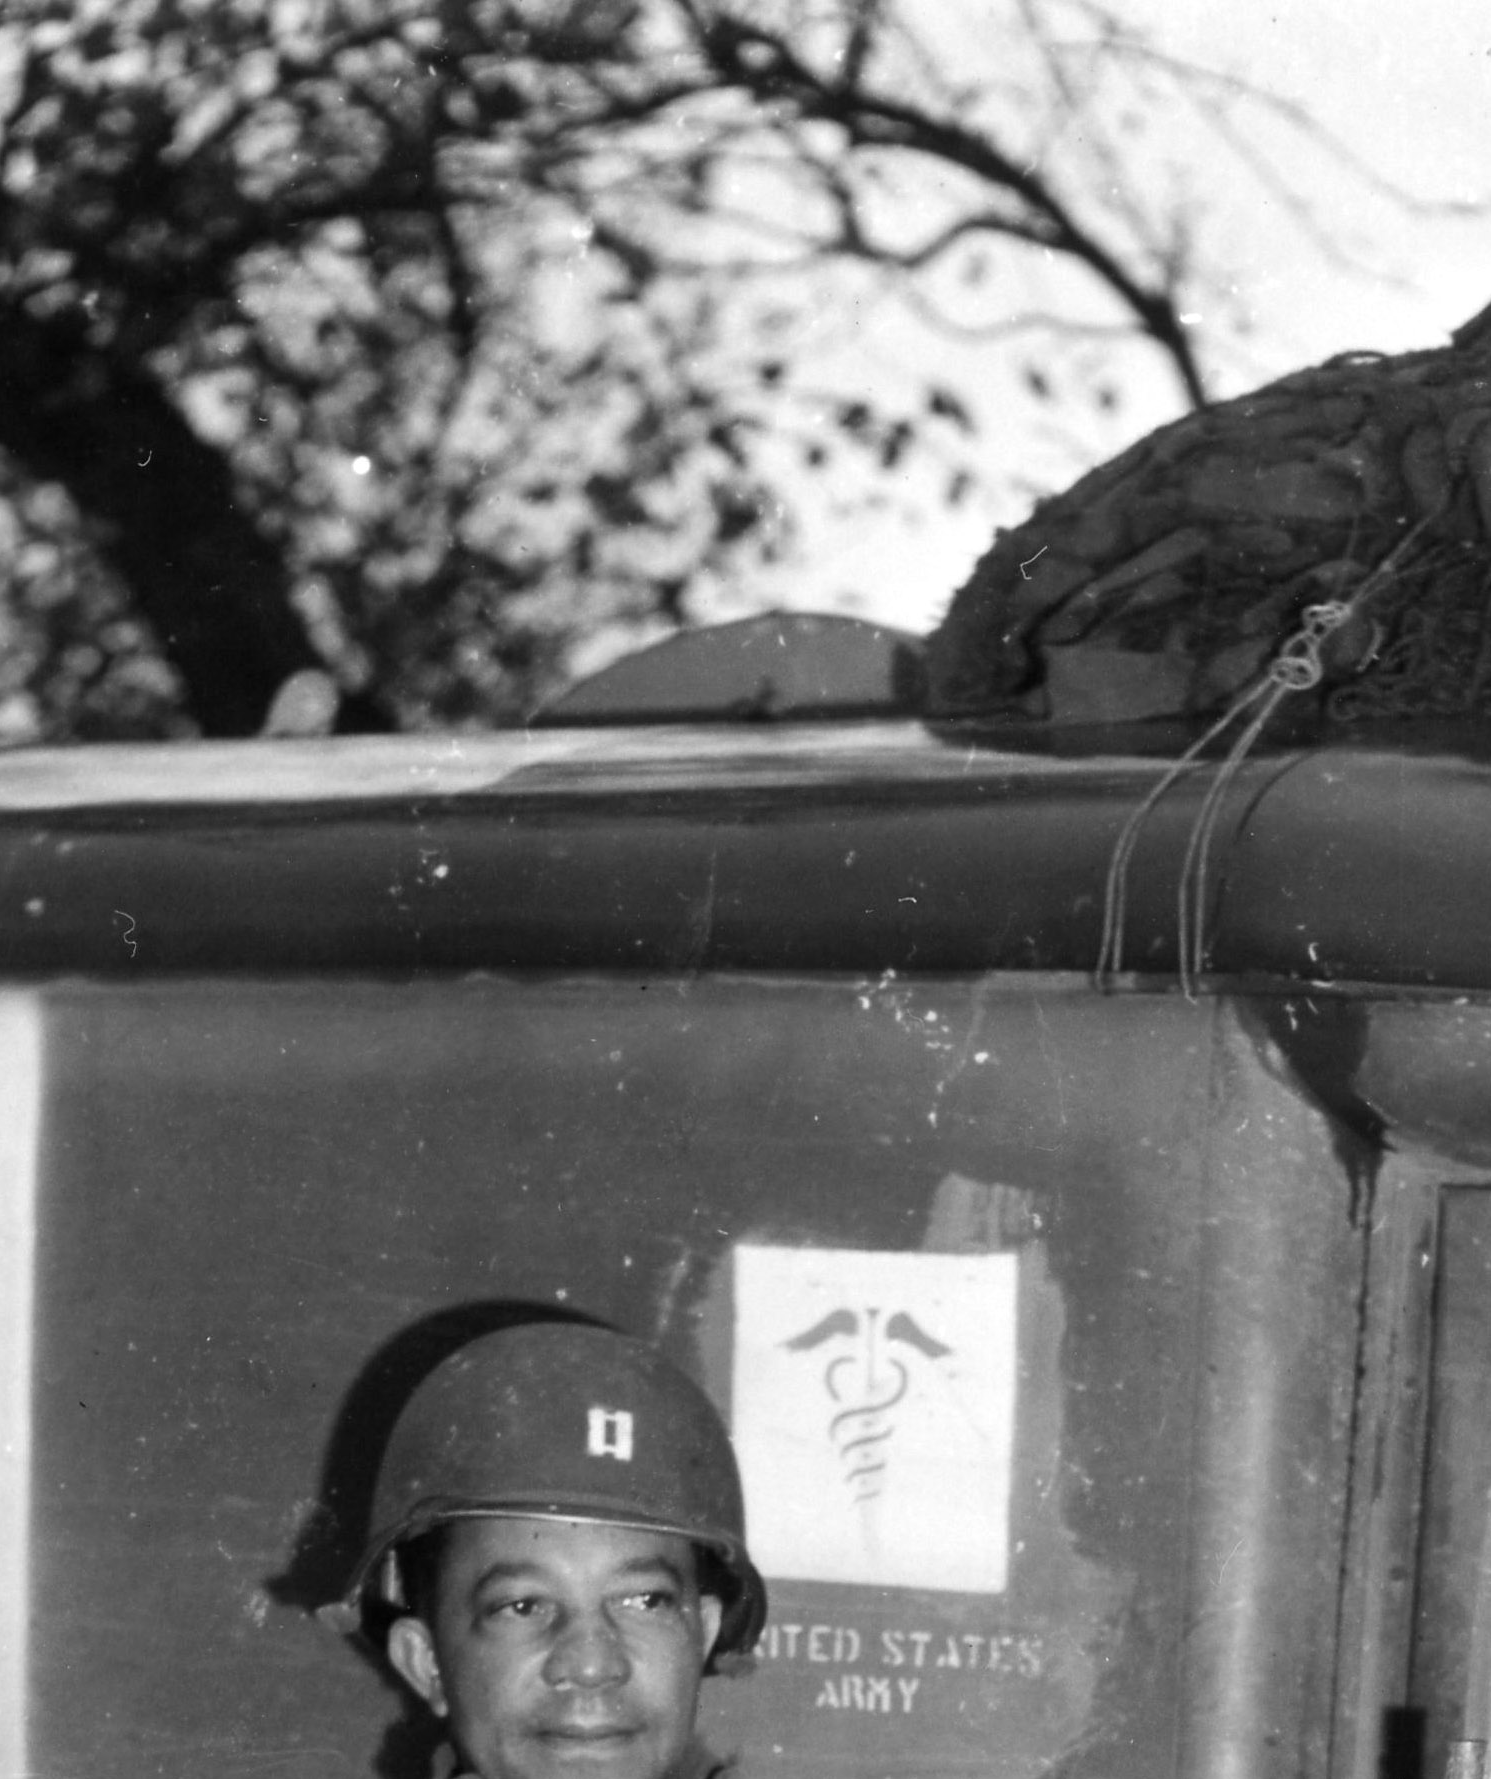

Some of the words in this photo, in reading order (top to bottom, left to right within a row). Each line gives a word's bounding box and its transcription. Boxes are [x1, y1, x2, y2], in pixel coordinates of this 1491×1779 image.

[753, 1624, 860, 1663] ITED
[881, 1630, 1044, 1677] STATES
[815, 1674, 920, 1713] ARMY
